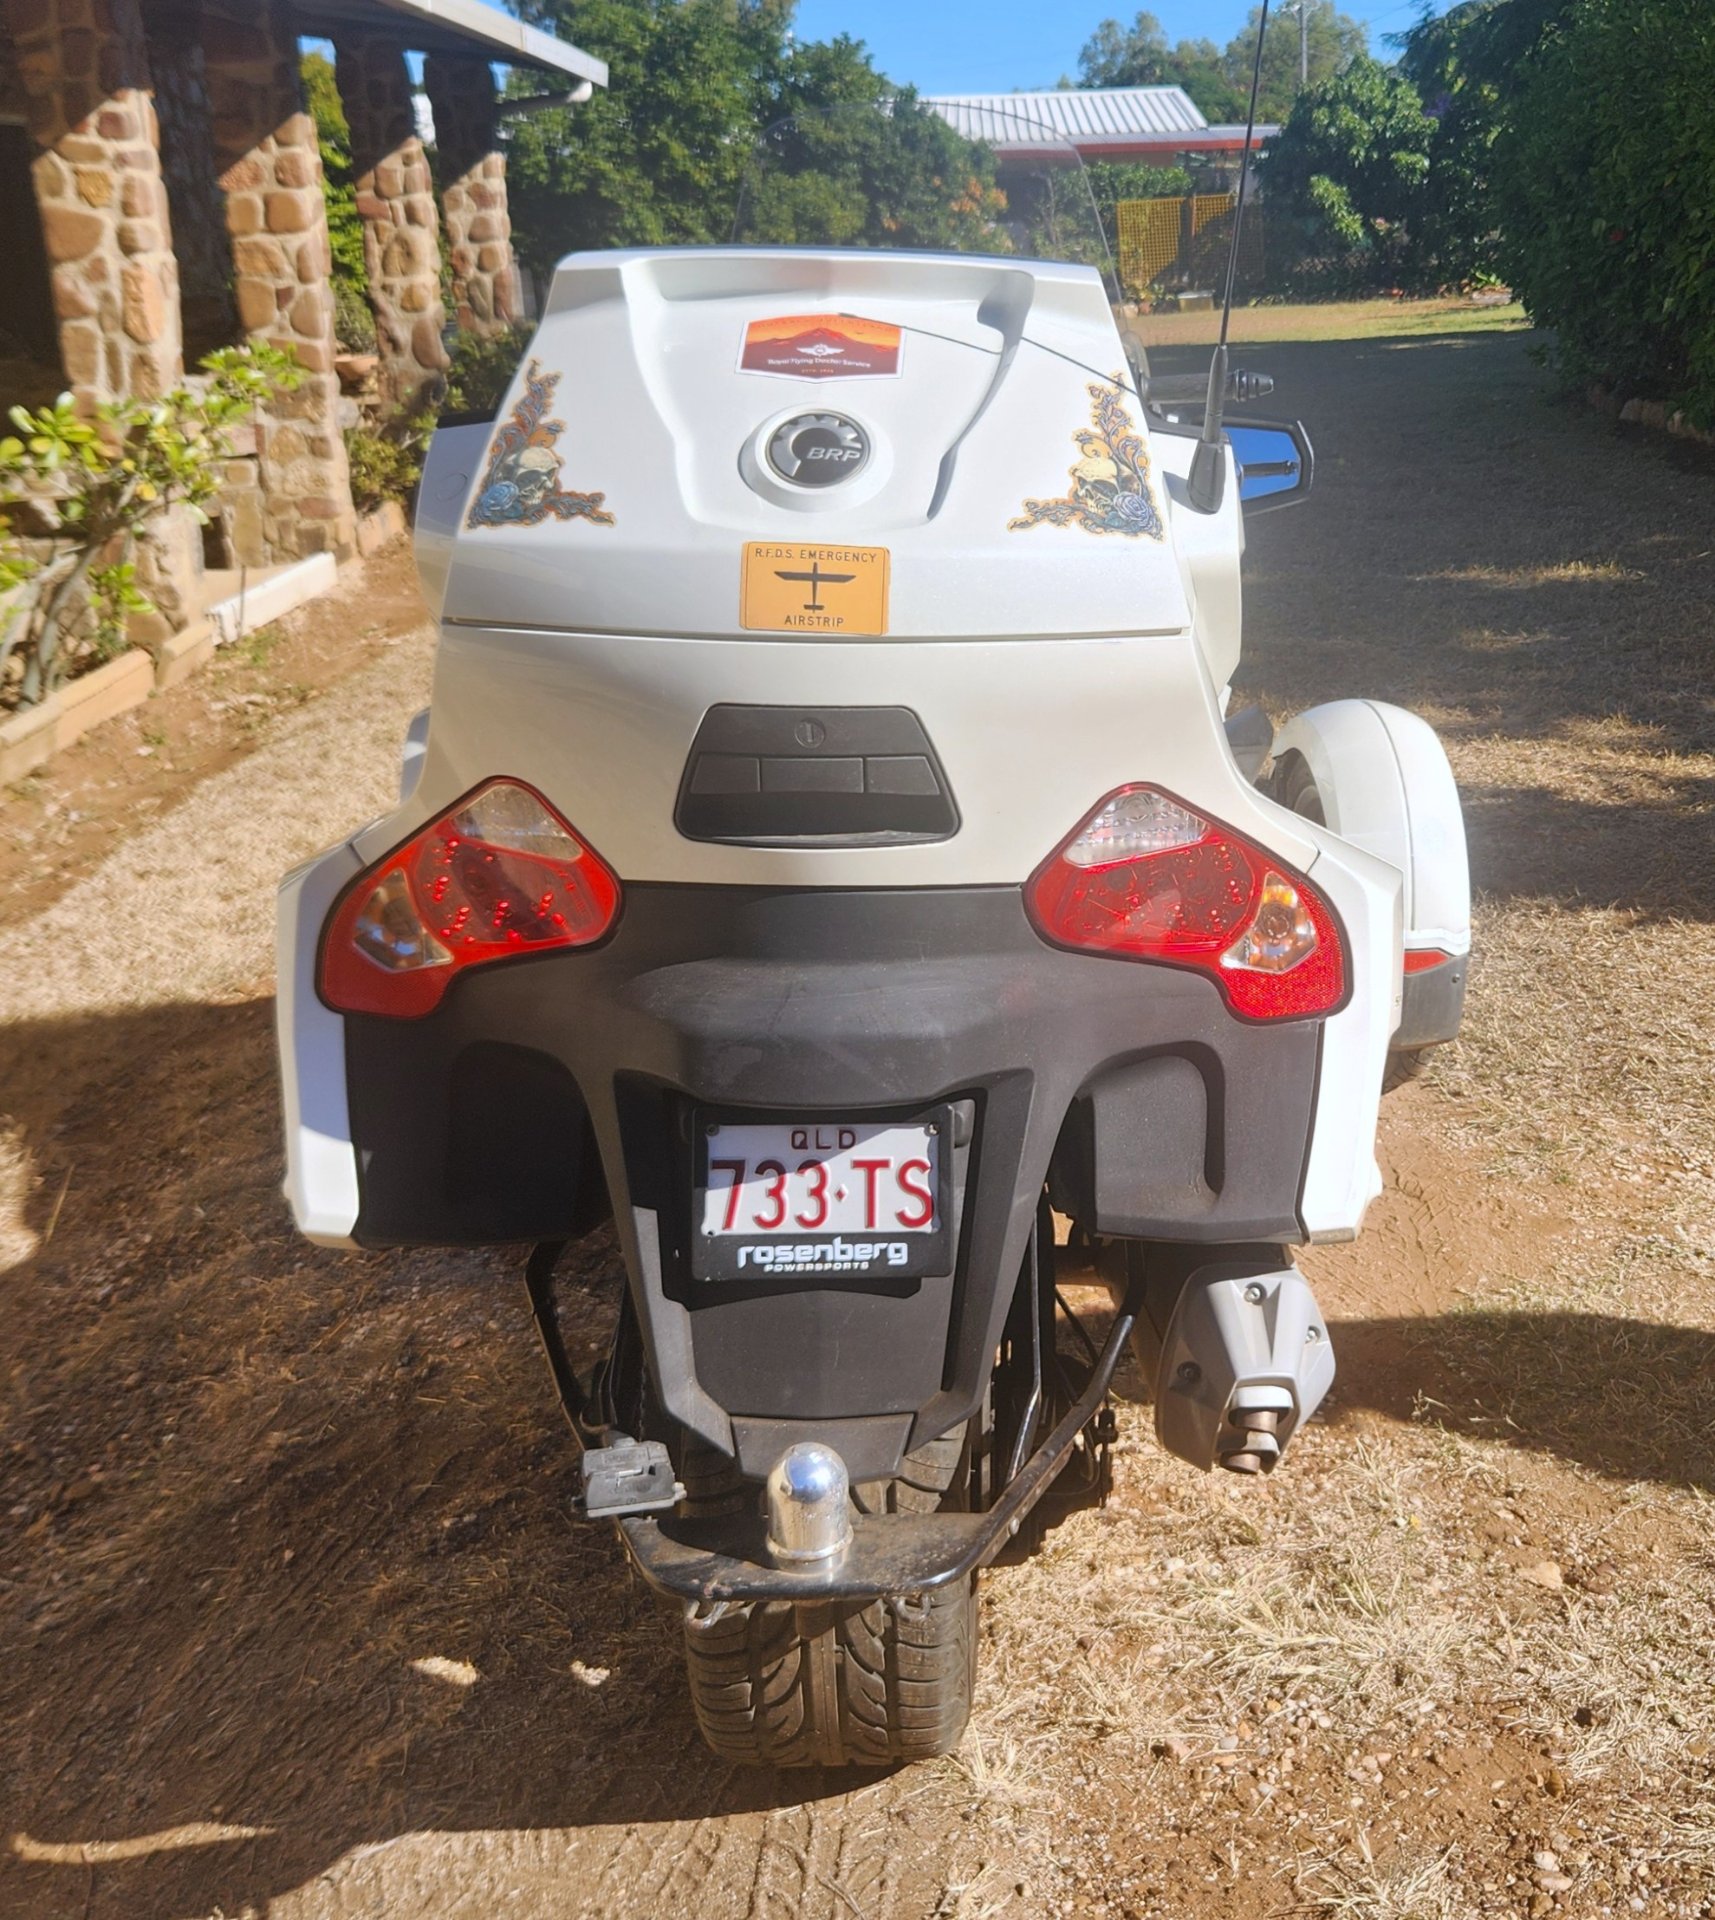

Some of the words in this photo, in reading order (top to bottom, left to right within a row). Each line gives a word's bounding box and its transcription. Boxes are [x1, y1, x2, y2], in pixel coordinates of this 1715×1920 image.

[807, 447, 861, 462] BRP
[800, 550, 877, 563] EMERGENCY
[784, 616, 844, 627] AIRSTRIP
[791, 1130, 856, 1150] QLD
[737, 1236, 908, 1269] rosenberg
[764, 1261, 869, 1272] POWERSPORTS
